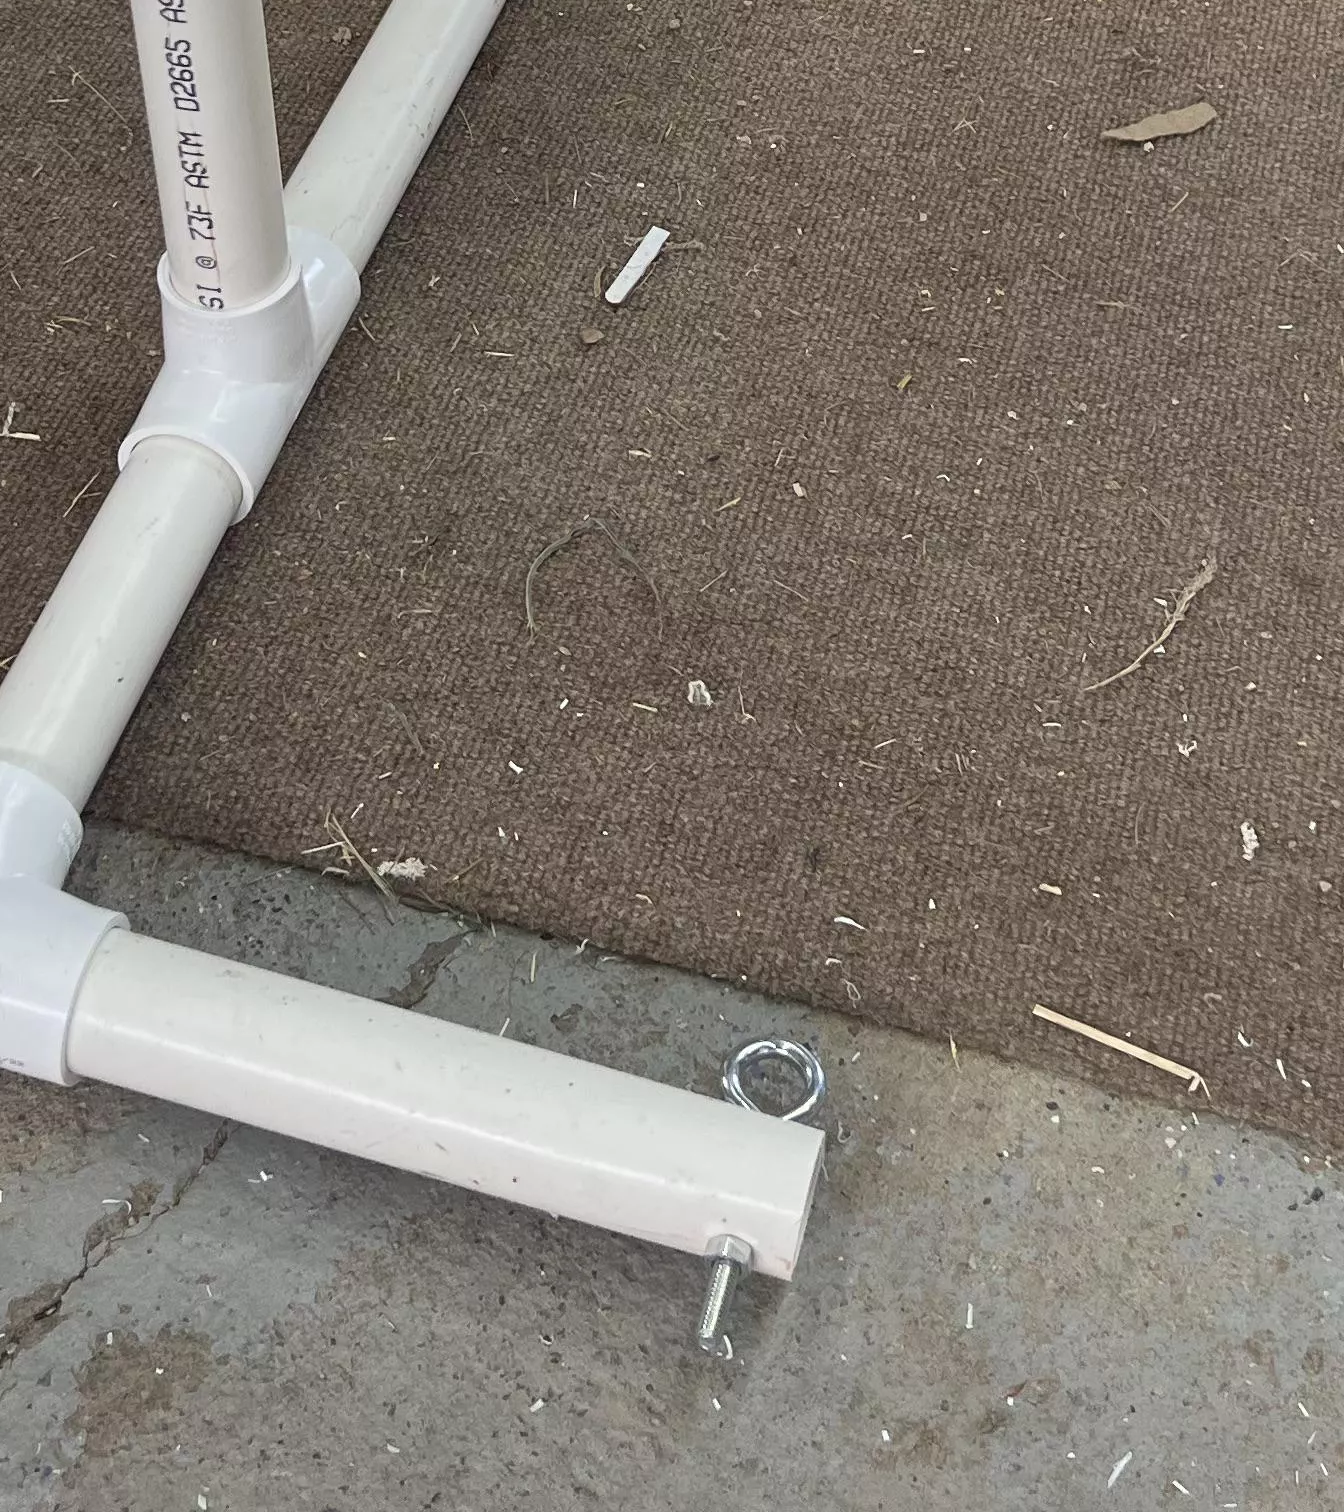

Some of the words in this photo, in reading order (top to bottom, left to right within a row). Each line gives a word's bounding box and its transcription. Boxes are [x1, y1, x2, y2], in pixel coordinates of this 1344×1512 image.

[165, 37, 201, 113] D2665
[176, 130, 210, 189] ASTM
[185, 200, 217, 242] 73F
[195, 255, 218, 270] @
